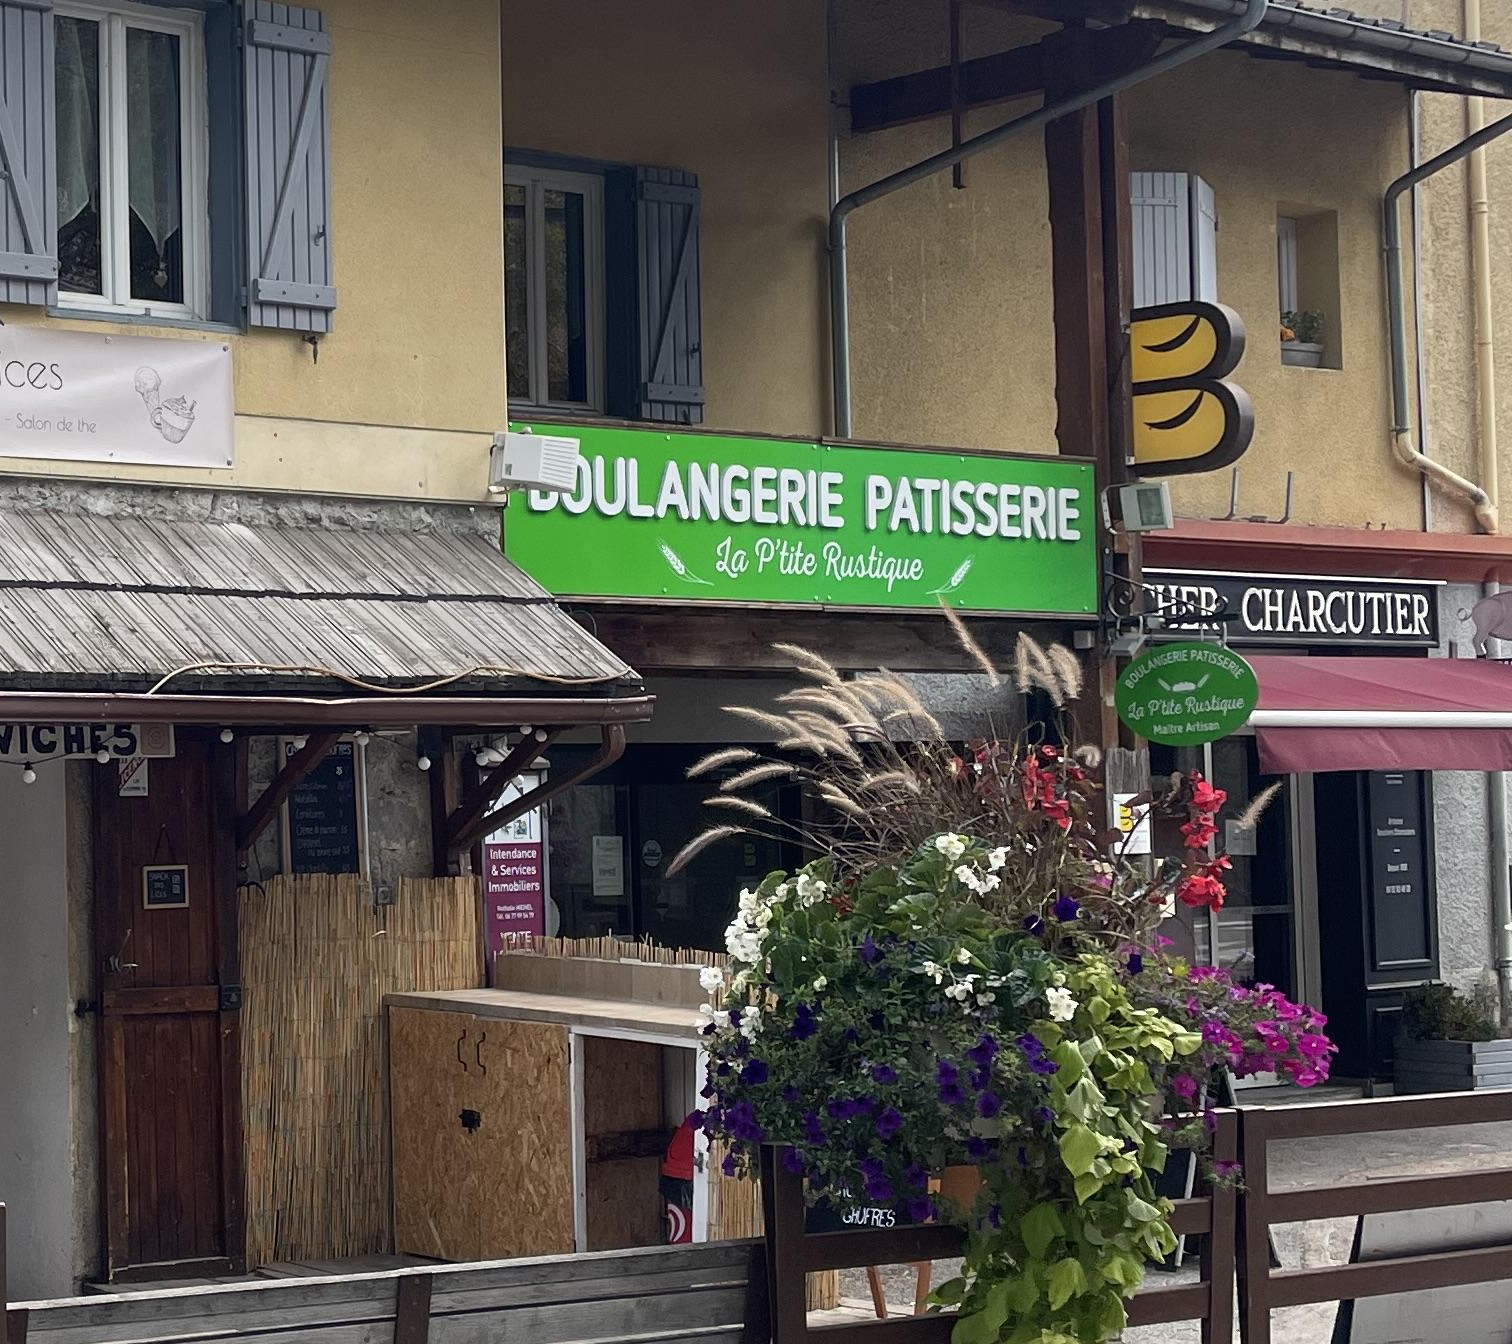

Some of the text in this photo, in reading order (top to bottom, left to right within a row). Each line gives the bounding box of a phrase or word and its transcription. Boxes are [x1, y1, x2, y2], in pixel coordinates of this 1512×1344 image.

[16, 412, 52, 432] Salon
[56, 416, 73, 432] de
[863, 473, 1083, 542] PATISSERIE
[715, 535, 925, 594] La P'tite Rustique
[1241, 585, 1431, 637] CHARCUTIER
[1125, 649, 1245, 689] BOULANGERIE PATISSERIE
[1128, 694, 1245, 720] La P'tite Rustique
[1153, 721, 1220, 735] Maître Artisan
[489, 848, 537, 860] Intendance
[491, 864, 537, 876] & Services
[488, 879, 540, 893] Immobiliers
